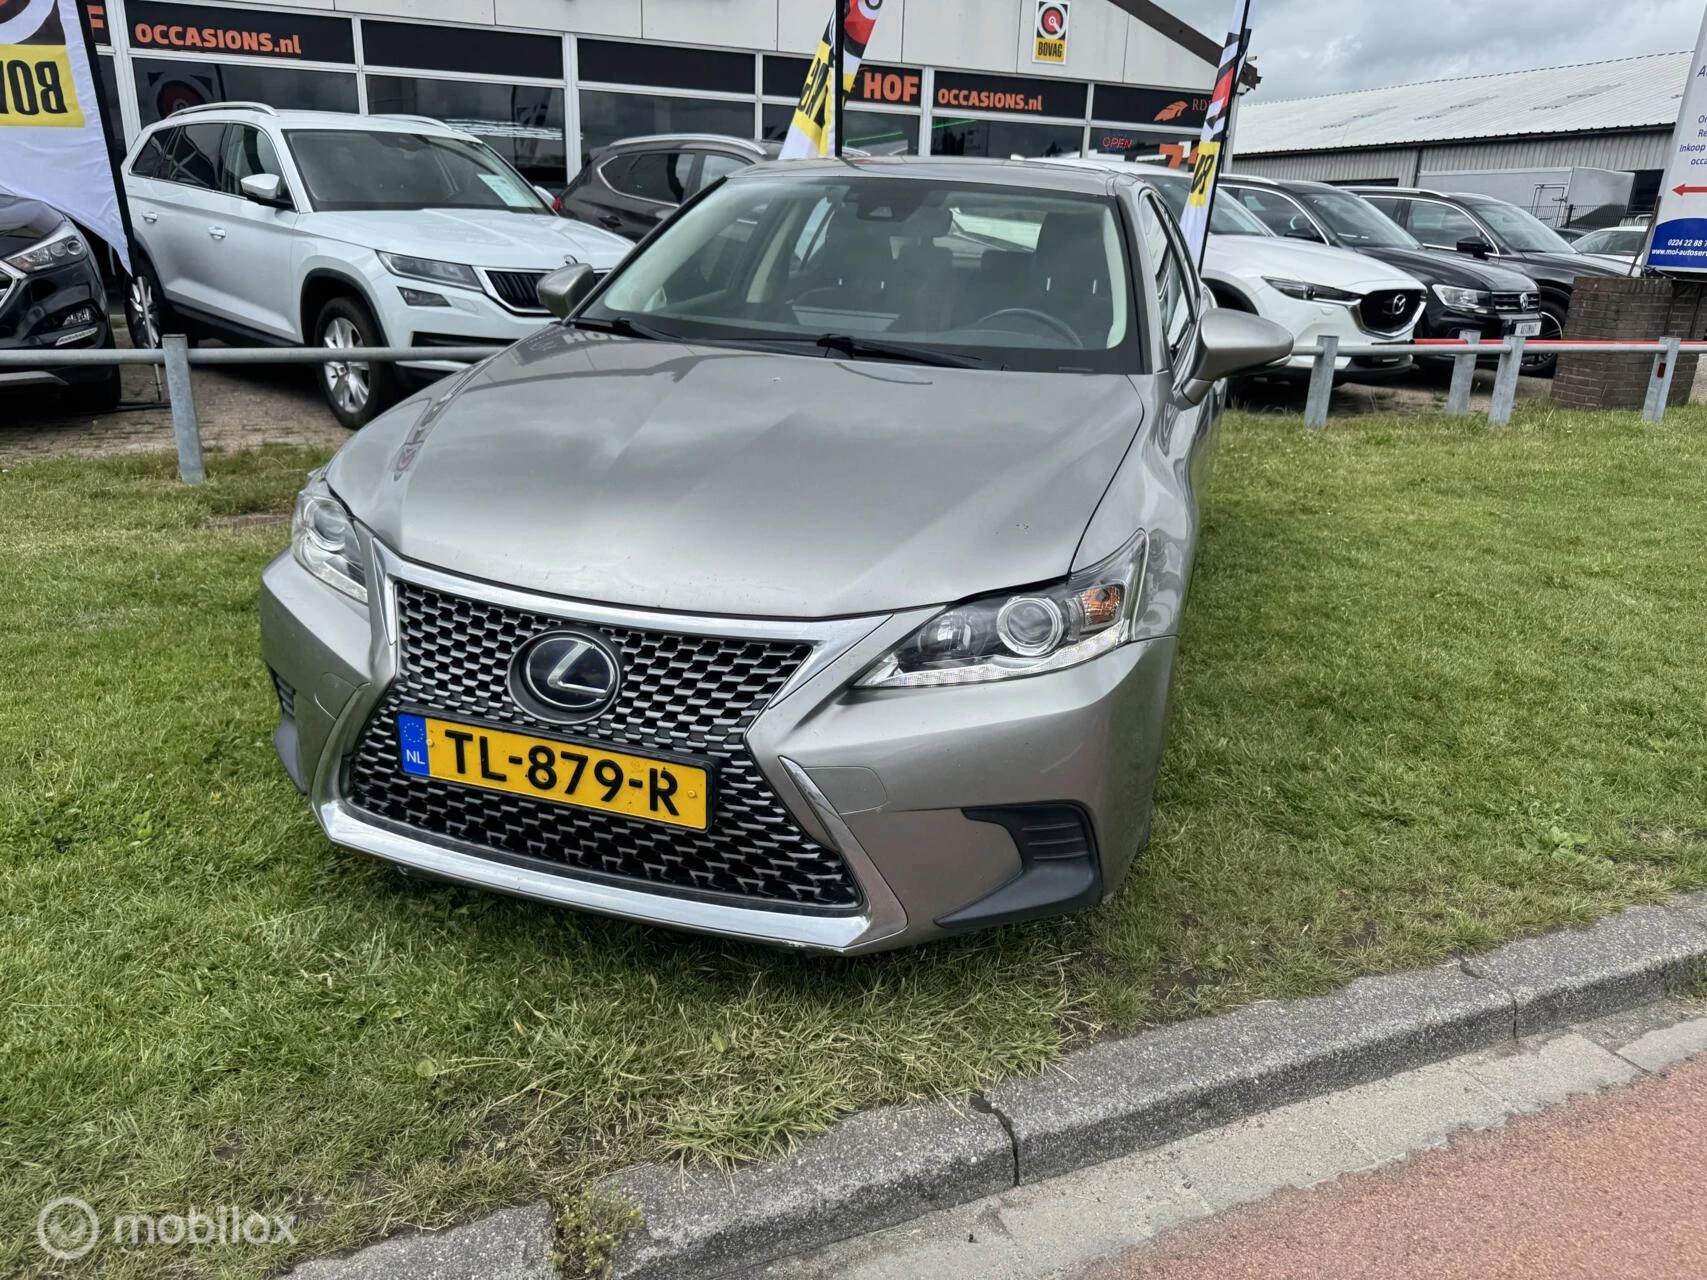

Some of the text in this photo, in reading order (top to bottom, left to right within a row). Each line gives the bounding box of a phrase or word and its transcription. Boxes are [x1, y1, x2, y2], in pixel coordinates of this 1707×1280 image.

[135, 23, 302, 54] OCCASIONS.nl
[1037, 41, 1063, 58] BOVAG
[863, 72, 1042, 112] HOF OCCASIONS.nl
[1102, 136, 1134, 150] OPEN
[1679, 143, 1706, 153] Inkoop
[1667, 239, 1683, 247] 0224
[1683, 239, 1693, 247] 22
[406, 748, 426, 765] NL
[445, 729, 680, 817] TL-879-R
